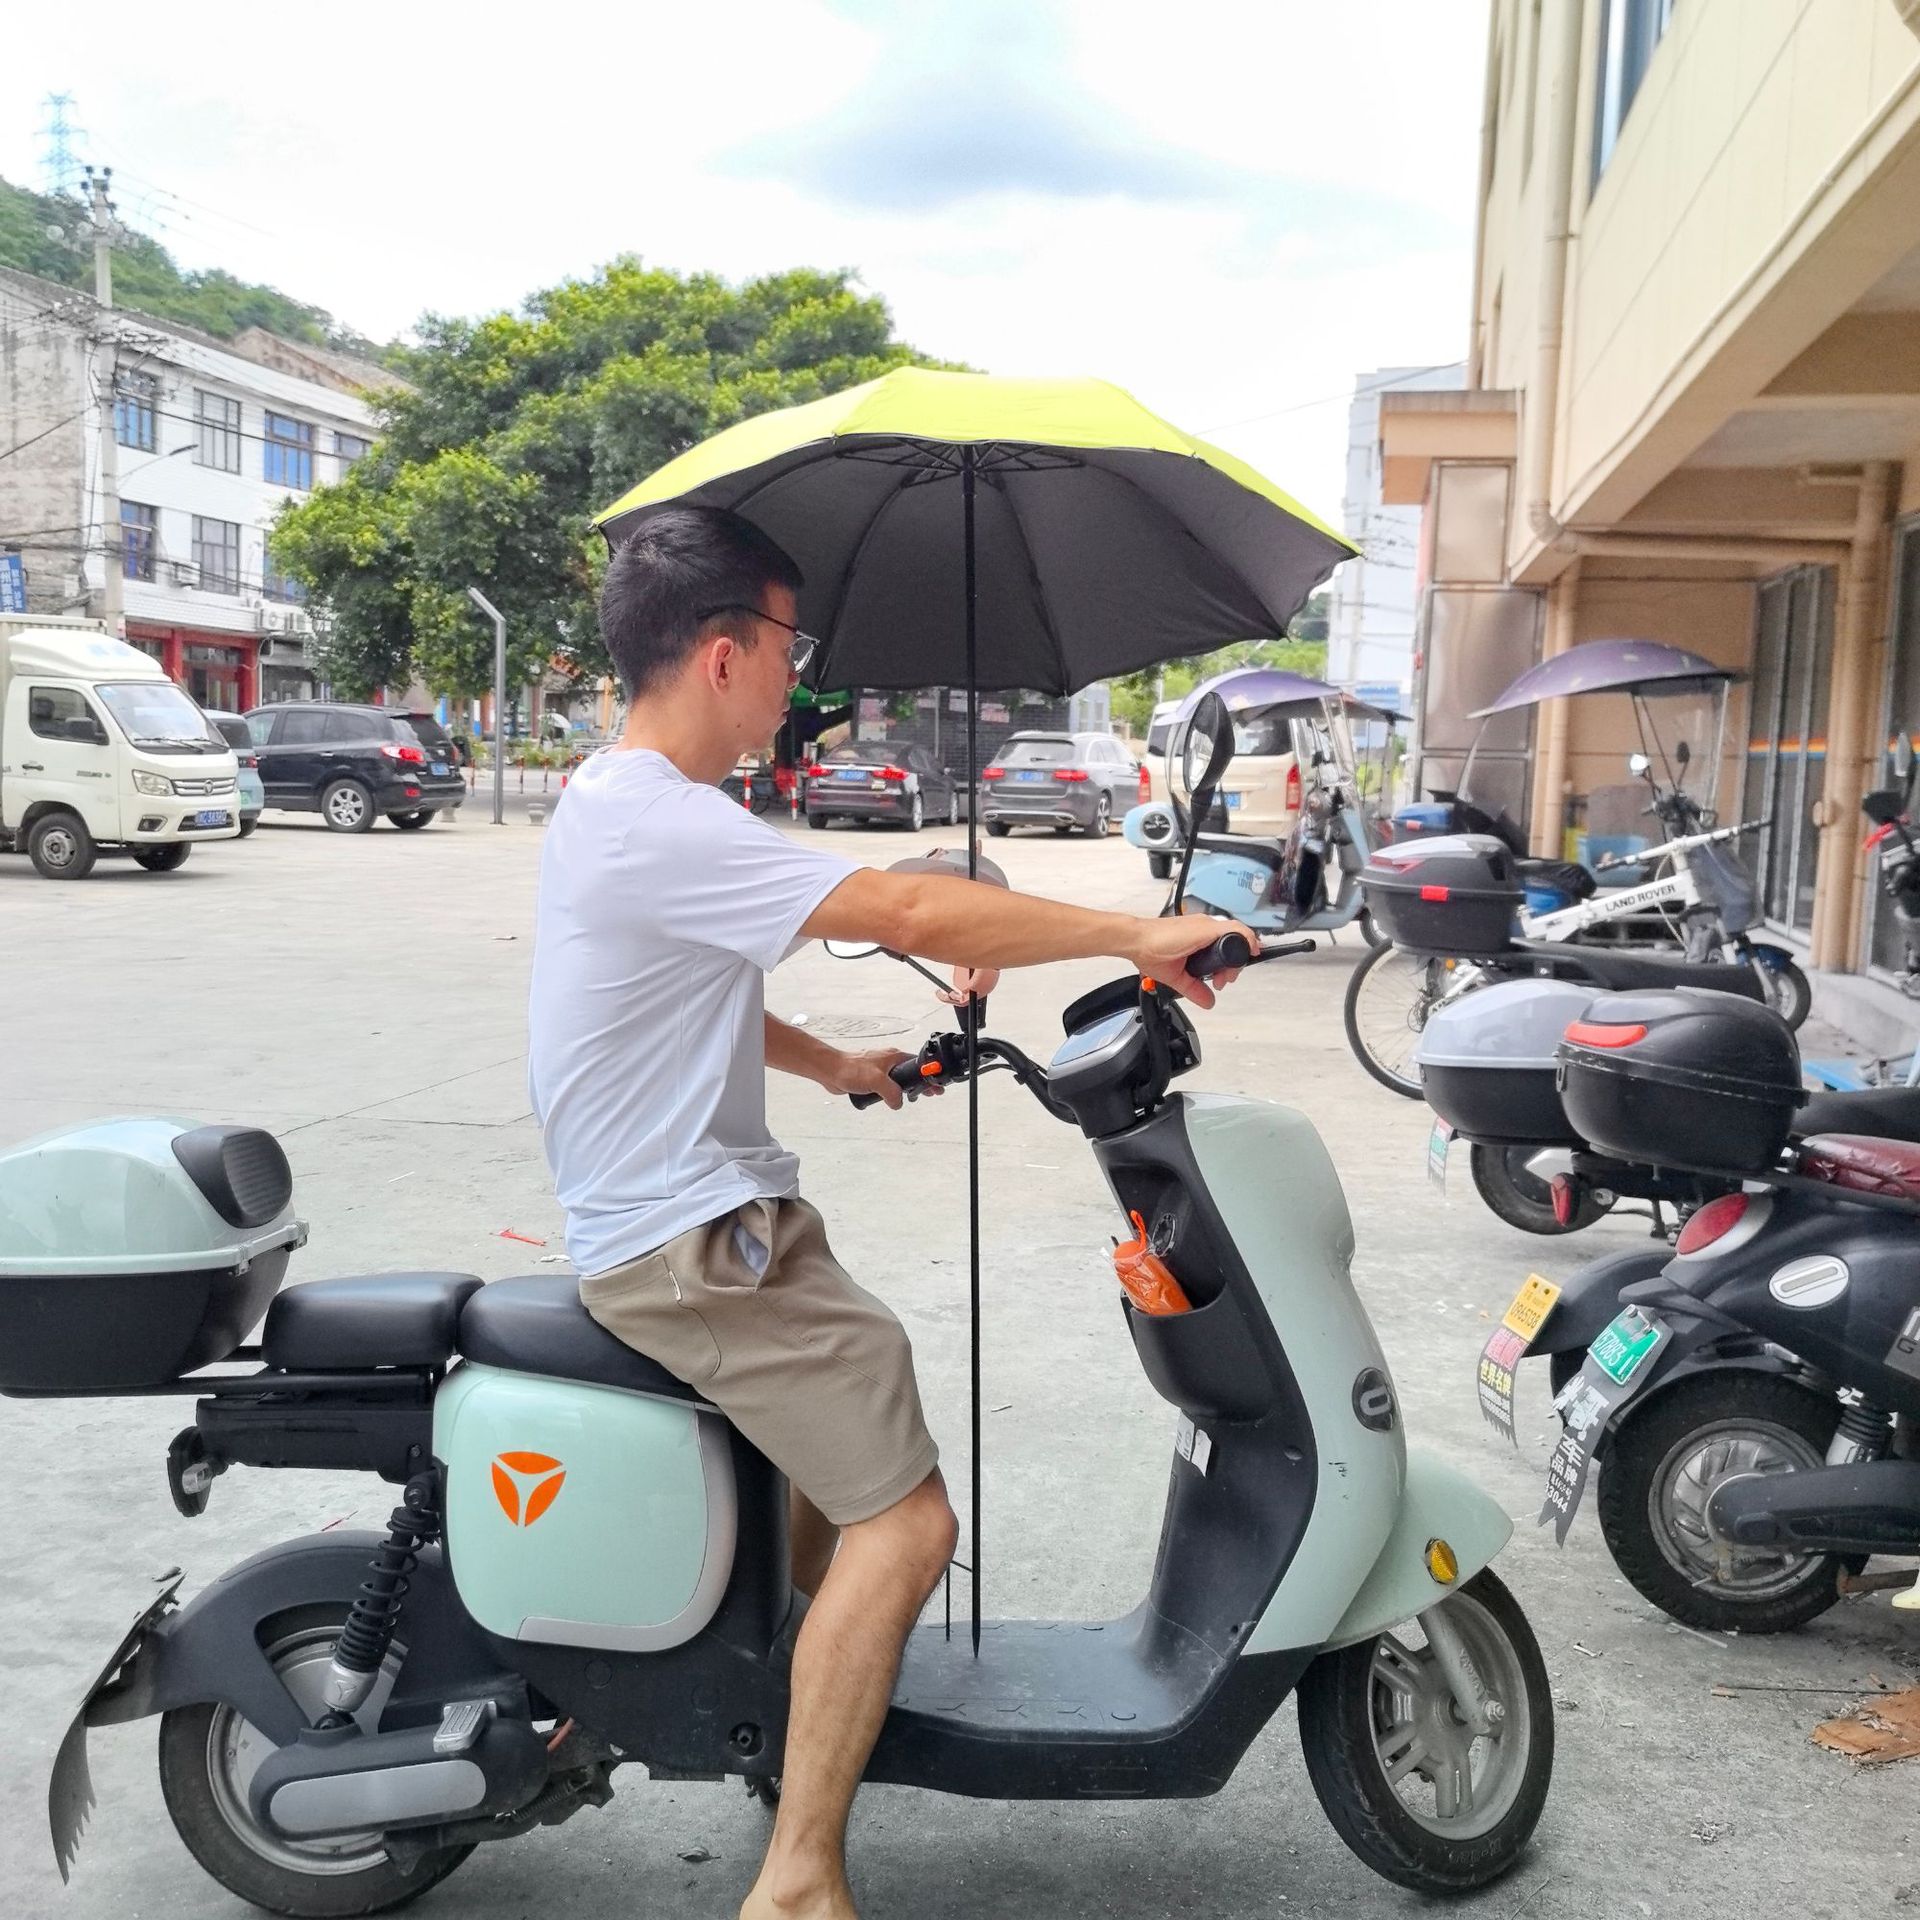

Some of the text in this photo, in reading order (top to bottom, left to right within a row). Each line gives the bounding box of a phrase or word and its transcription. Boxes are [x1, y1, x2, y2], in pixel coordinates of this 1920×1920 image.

[1605, 884, 1676, 912] LAND ROVER
[1550, 1454, 1578, 1487] 品牌
